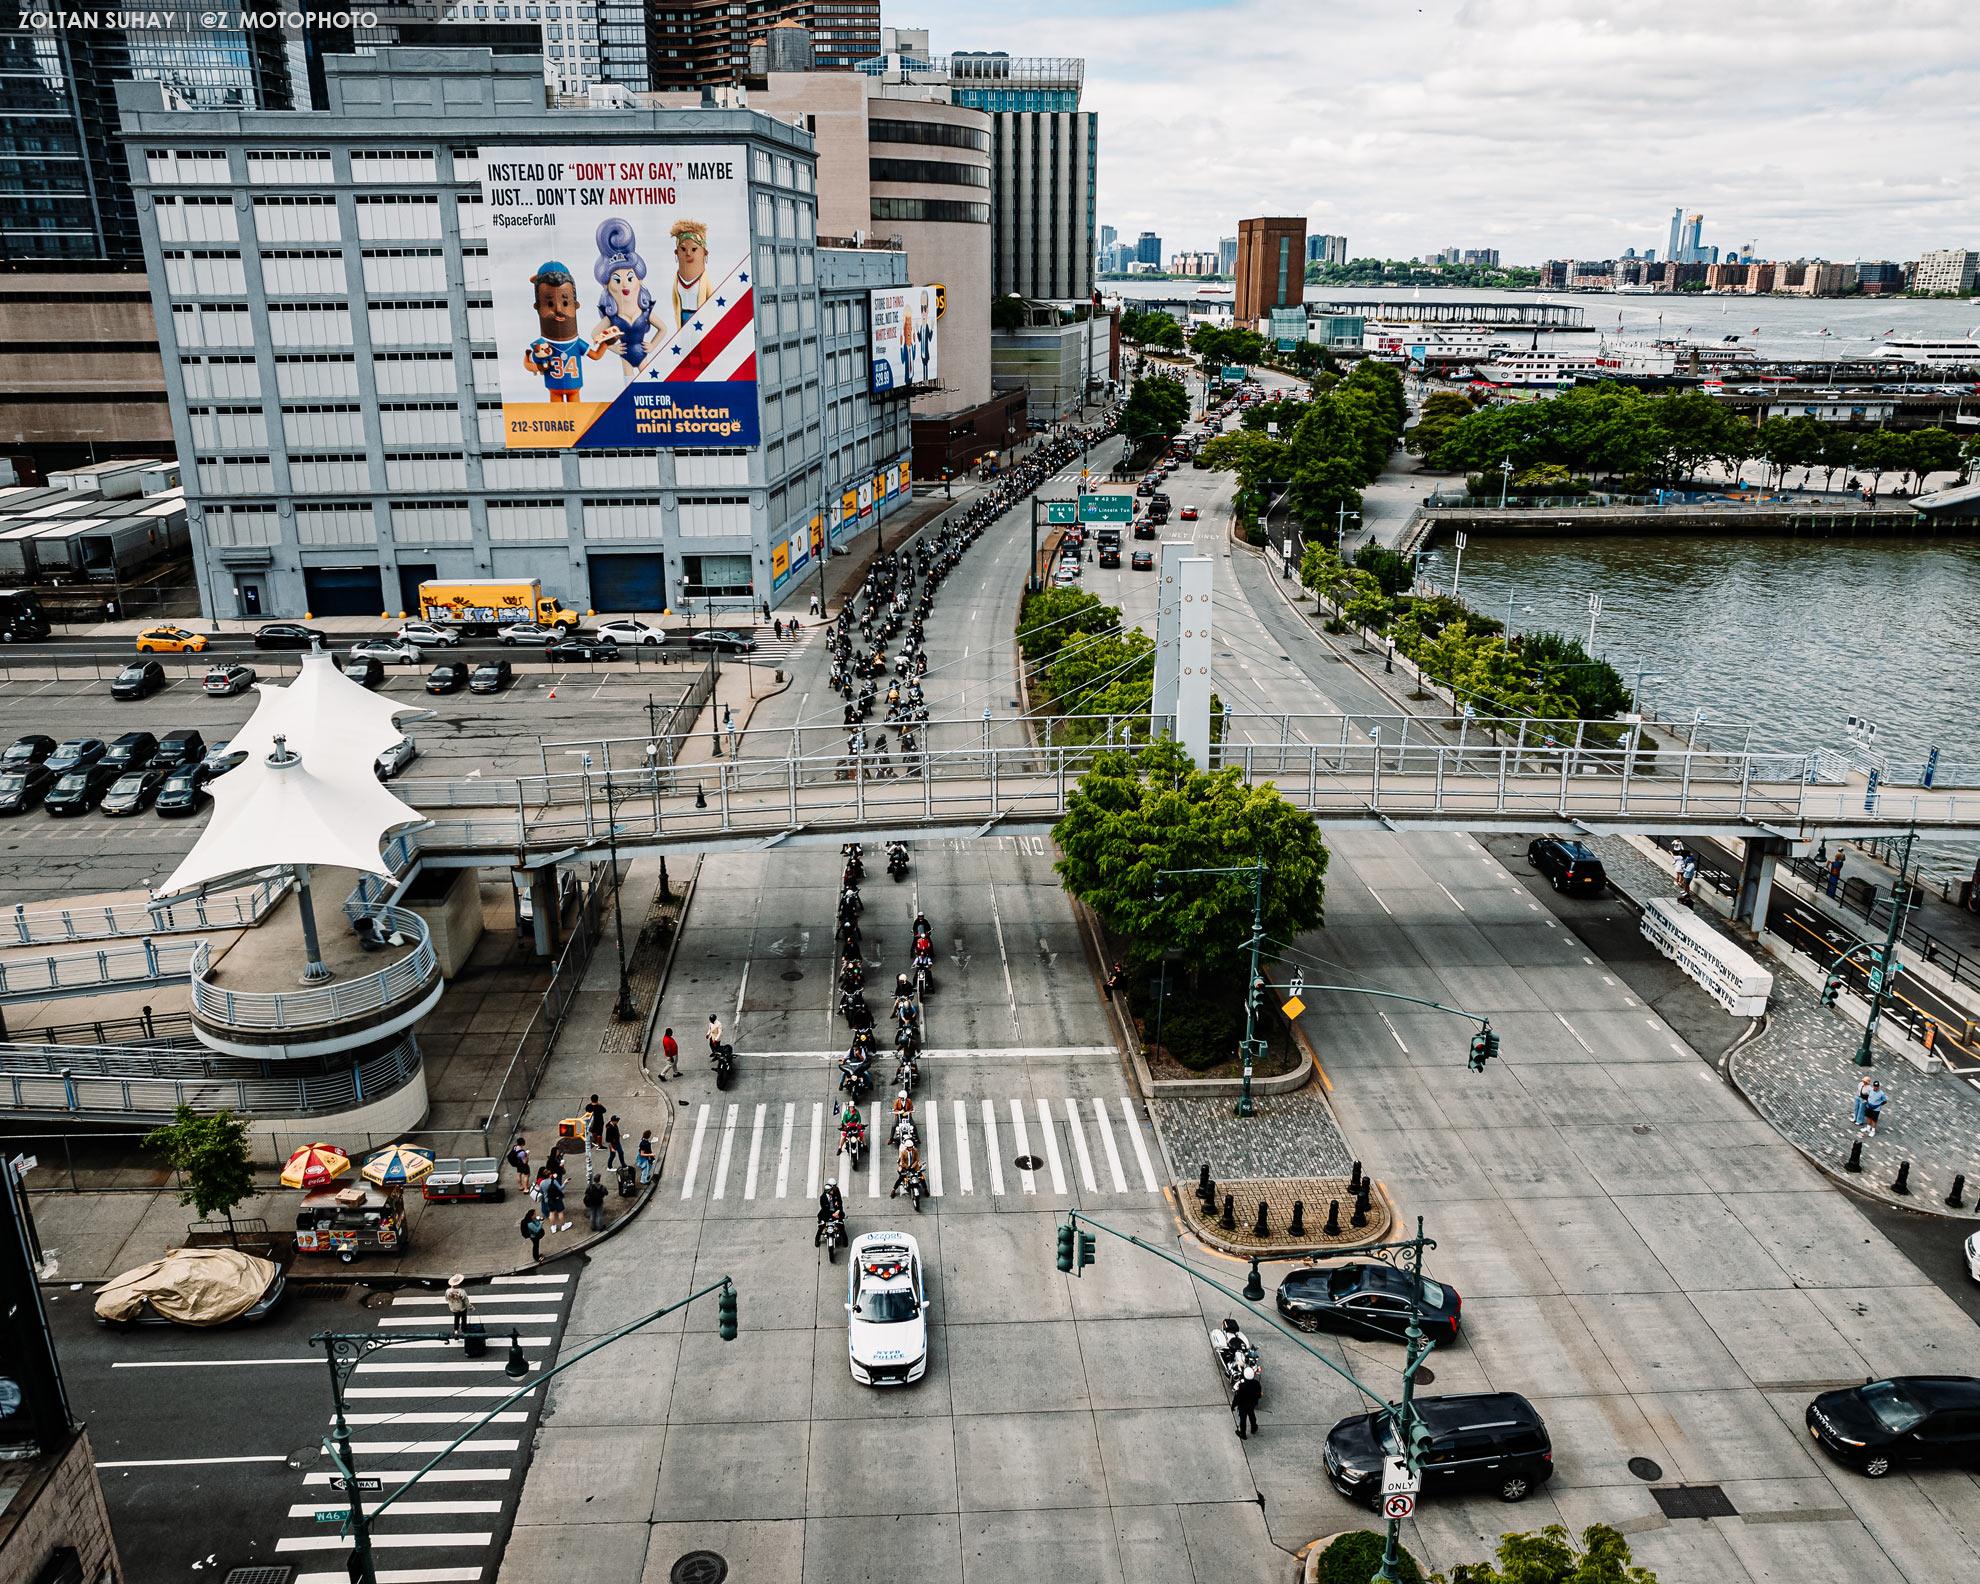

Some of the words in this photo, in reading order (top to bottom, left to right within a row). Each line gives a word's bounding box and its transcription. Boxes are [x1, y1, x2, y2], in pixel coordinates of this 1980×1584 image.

[488, 163, 545, 182] INSTEAD
[548, 163, 565, 181] OF
[620, 162, 645, 181] SAY
[687, 162, 734, 180] MAYBE
[490, 188, 533, 207] JUST...
[580, 187, 605, 205] SAY
[609, 187, 676, 205] ANYTHING
[492, 213, 556, 227] #SpaceForAll
[550, 356, 579, 380] 34
[633, 395, 654, 407] VOTE
[655, 395, 671, 406] FOR
[635, 401, 729, 420] manhattan
[511, 420, 575, 433] 212-STORAGE
[636, 420, 672, 434] mini
[675, 420, 741, 437] storage
[1388, 1482, 1414, 1491] ONLY
